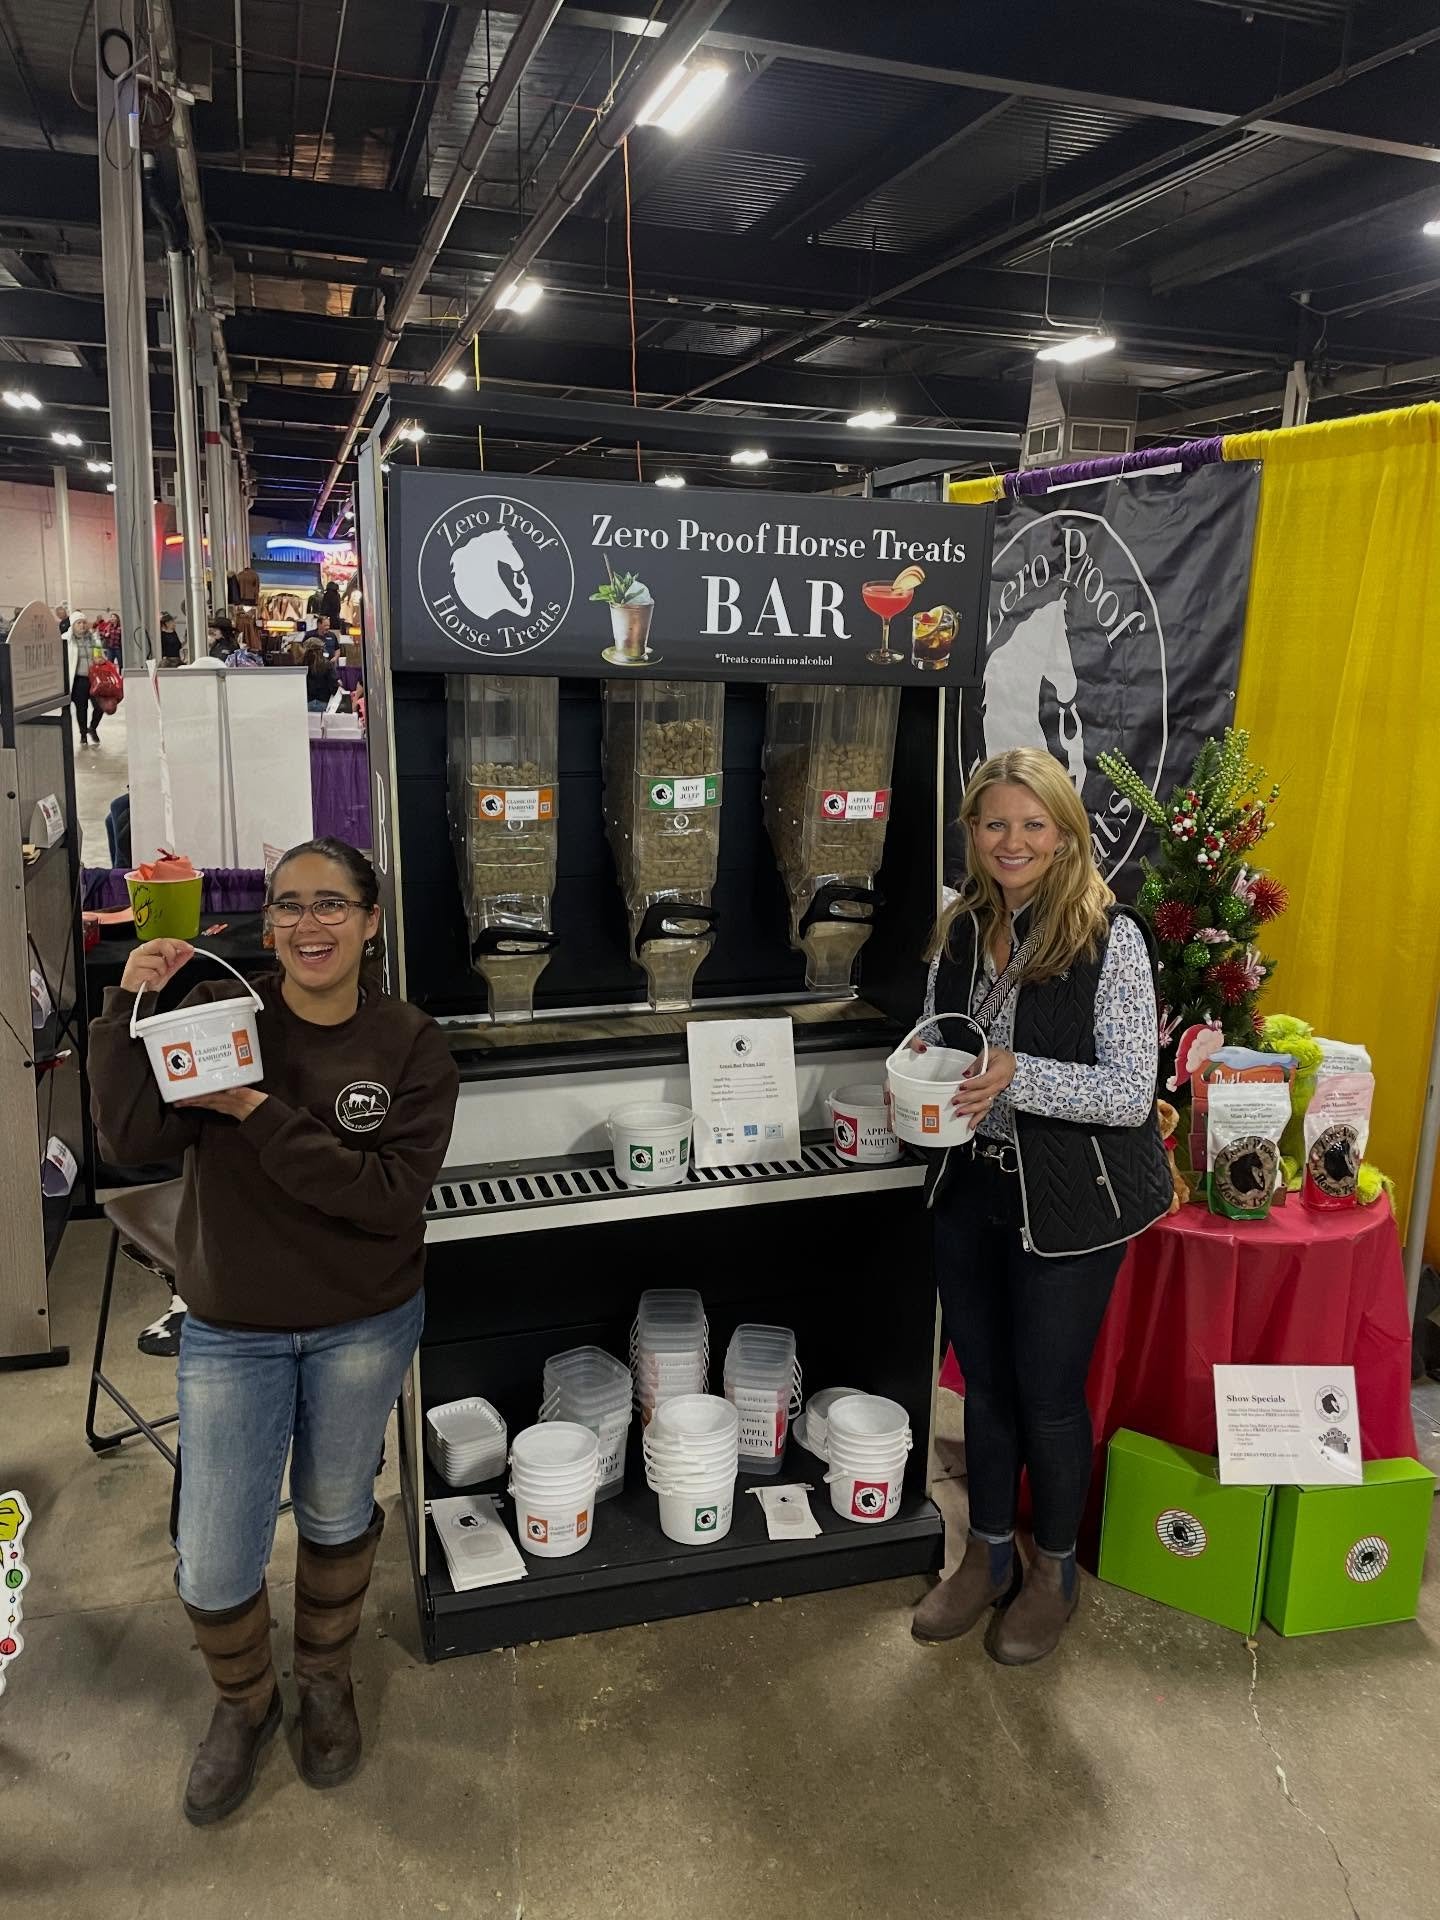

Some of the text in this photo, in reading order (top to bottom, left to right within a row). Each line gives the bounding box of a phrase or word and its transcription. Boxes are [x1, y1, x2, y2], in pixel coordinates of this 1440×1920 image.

[437, 502, 559, 551] Zero Proof
[591, 514, 966, 563] Zero Proof Horse Treats
[699, 575, 852, 640] BAR
[1059, 527, 1147, 649] Proof
[432, 590, 562, 649] Horse Treats
[750, 654, 785, 665] contain
[786, 657, 799, 665] no
[799, 655, 833, 666] alcohol
[1226, 1394, 1286, 1404] Show Specials
[742, 1428, 768, 1437] APPLE
